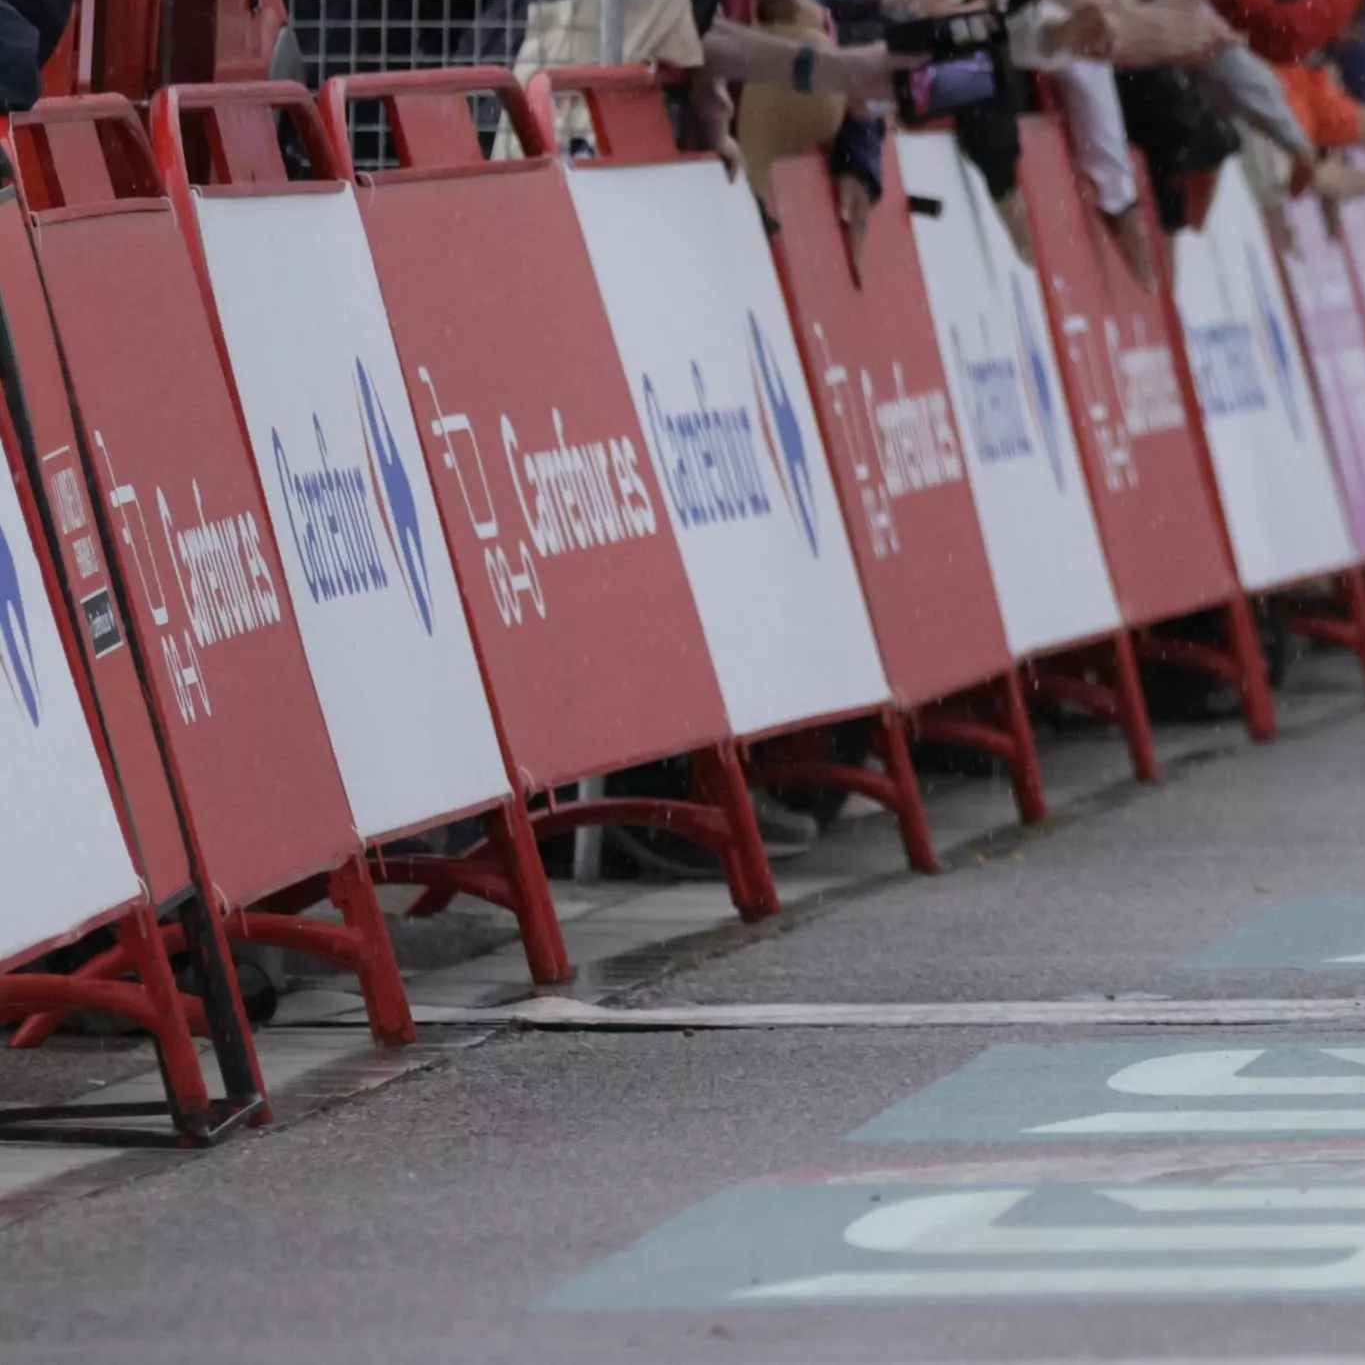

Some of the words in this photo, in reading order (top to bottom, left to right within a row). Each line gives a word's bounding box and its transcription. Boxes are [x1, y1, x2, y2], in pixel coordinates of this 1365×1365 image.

[155, 477, 282, 649] Carrefour.es
[271, 410, 389, 605] Carrefour
[500, 406, 657, 558] Carrefour.es
